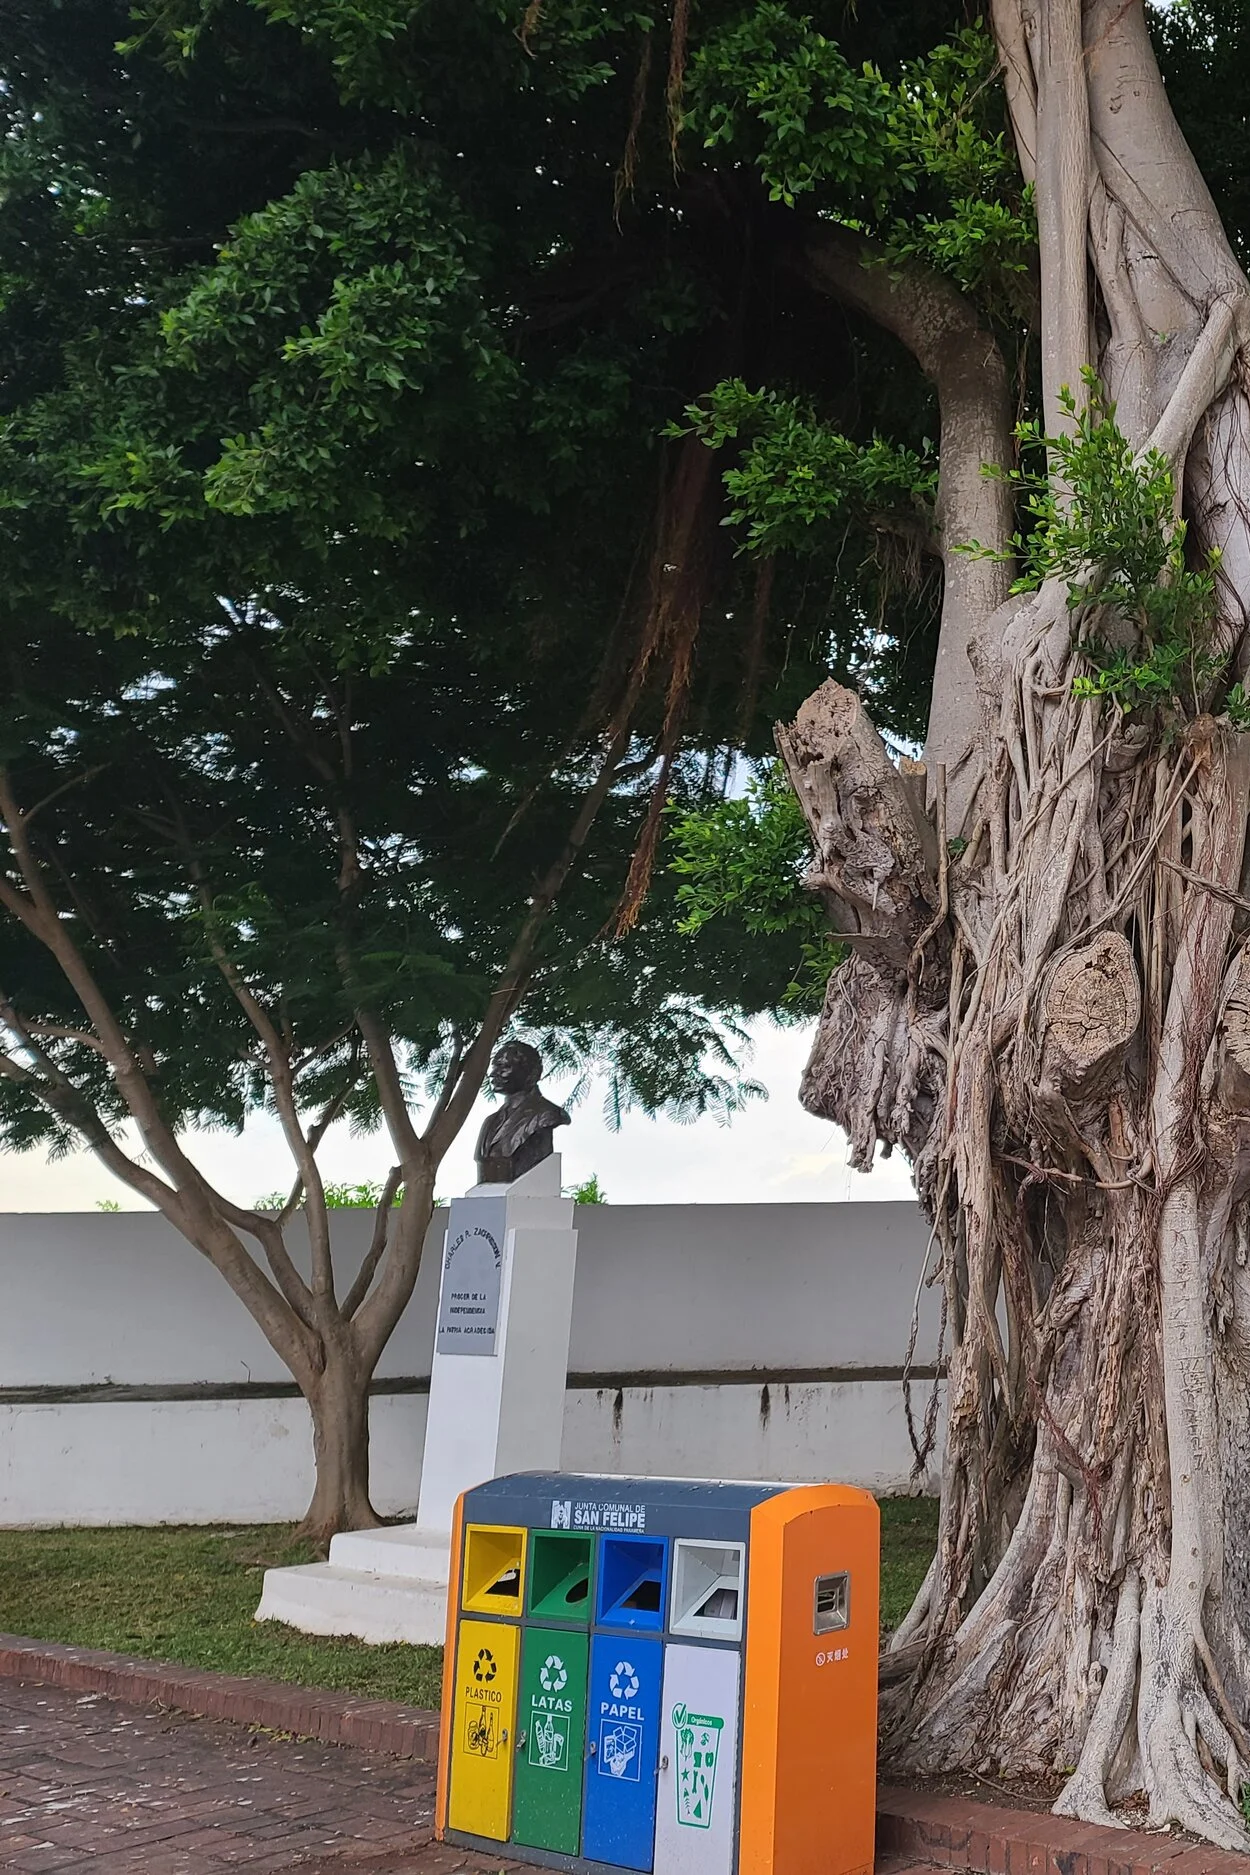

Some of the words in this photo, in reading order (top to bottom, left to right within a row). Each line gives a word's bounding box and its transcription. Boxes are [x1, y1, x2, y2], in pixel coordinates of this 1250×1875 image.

[574, 1502, 597, 1510] JUNTA
[598, 1503, 633, 1512] COMUNAL
[635, 1505, 646, 1513] DE
[574, 1510, 600, 1525] SAN
[602, 1512, 646, 1528] FELIPE
[465, 1686, 502, 1703] PLASTICO
[531, 1694, 573, 1712] LATAS
[600, 1701, 645, 1721] PAPEL
